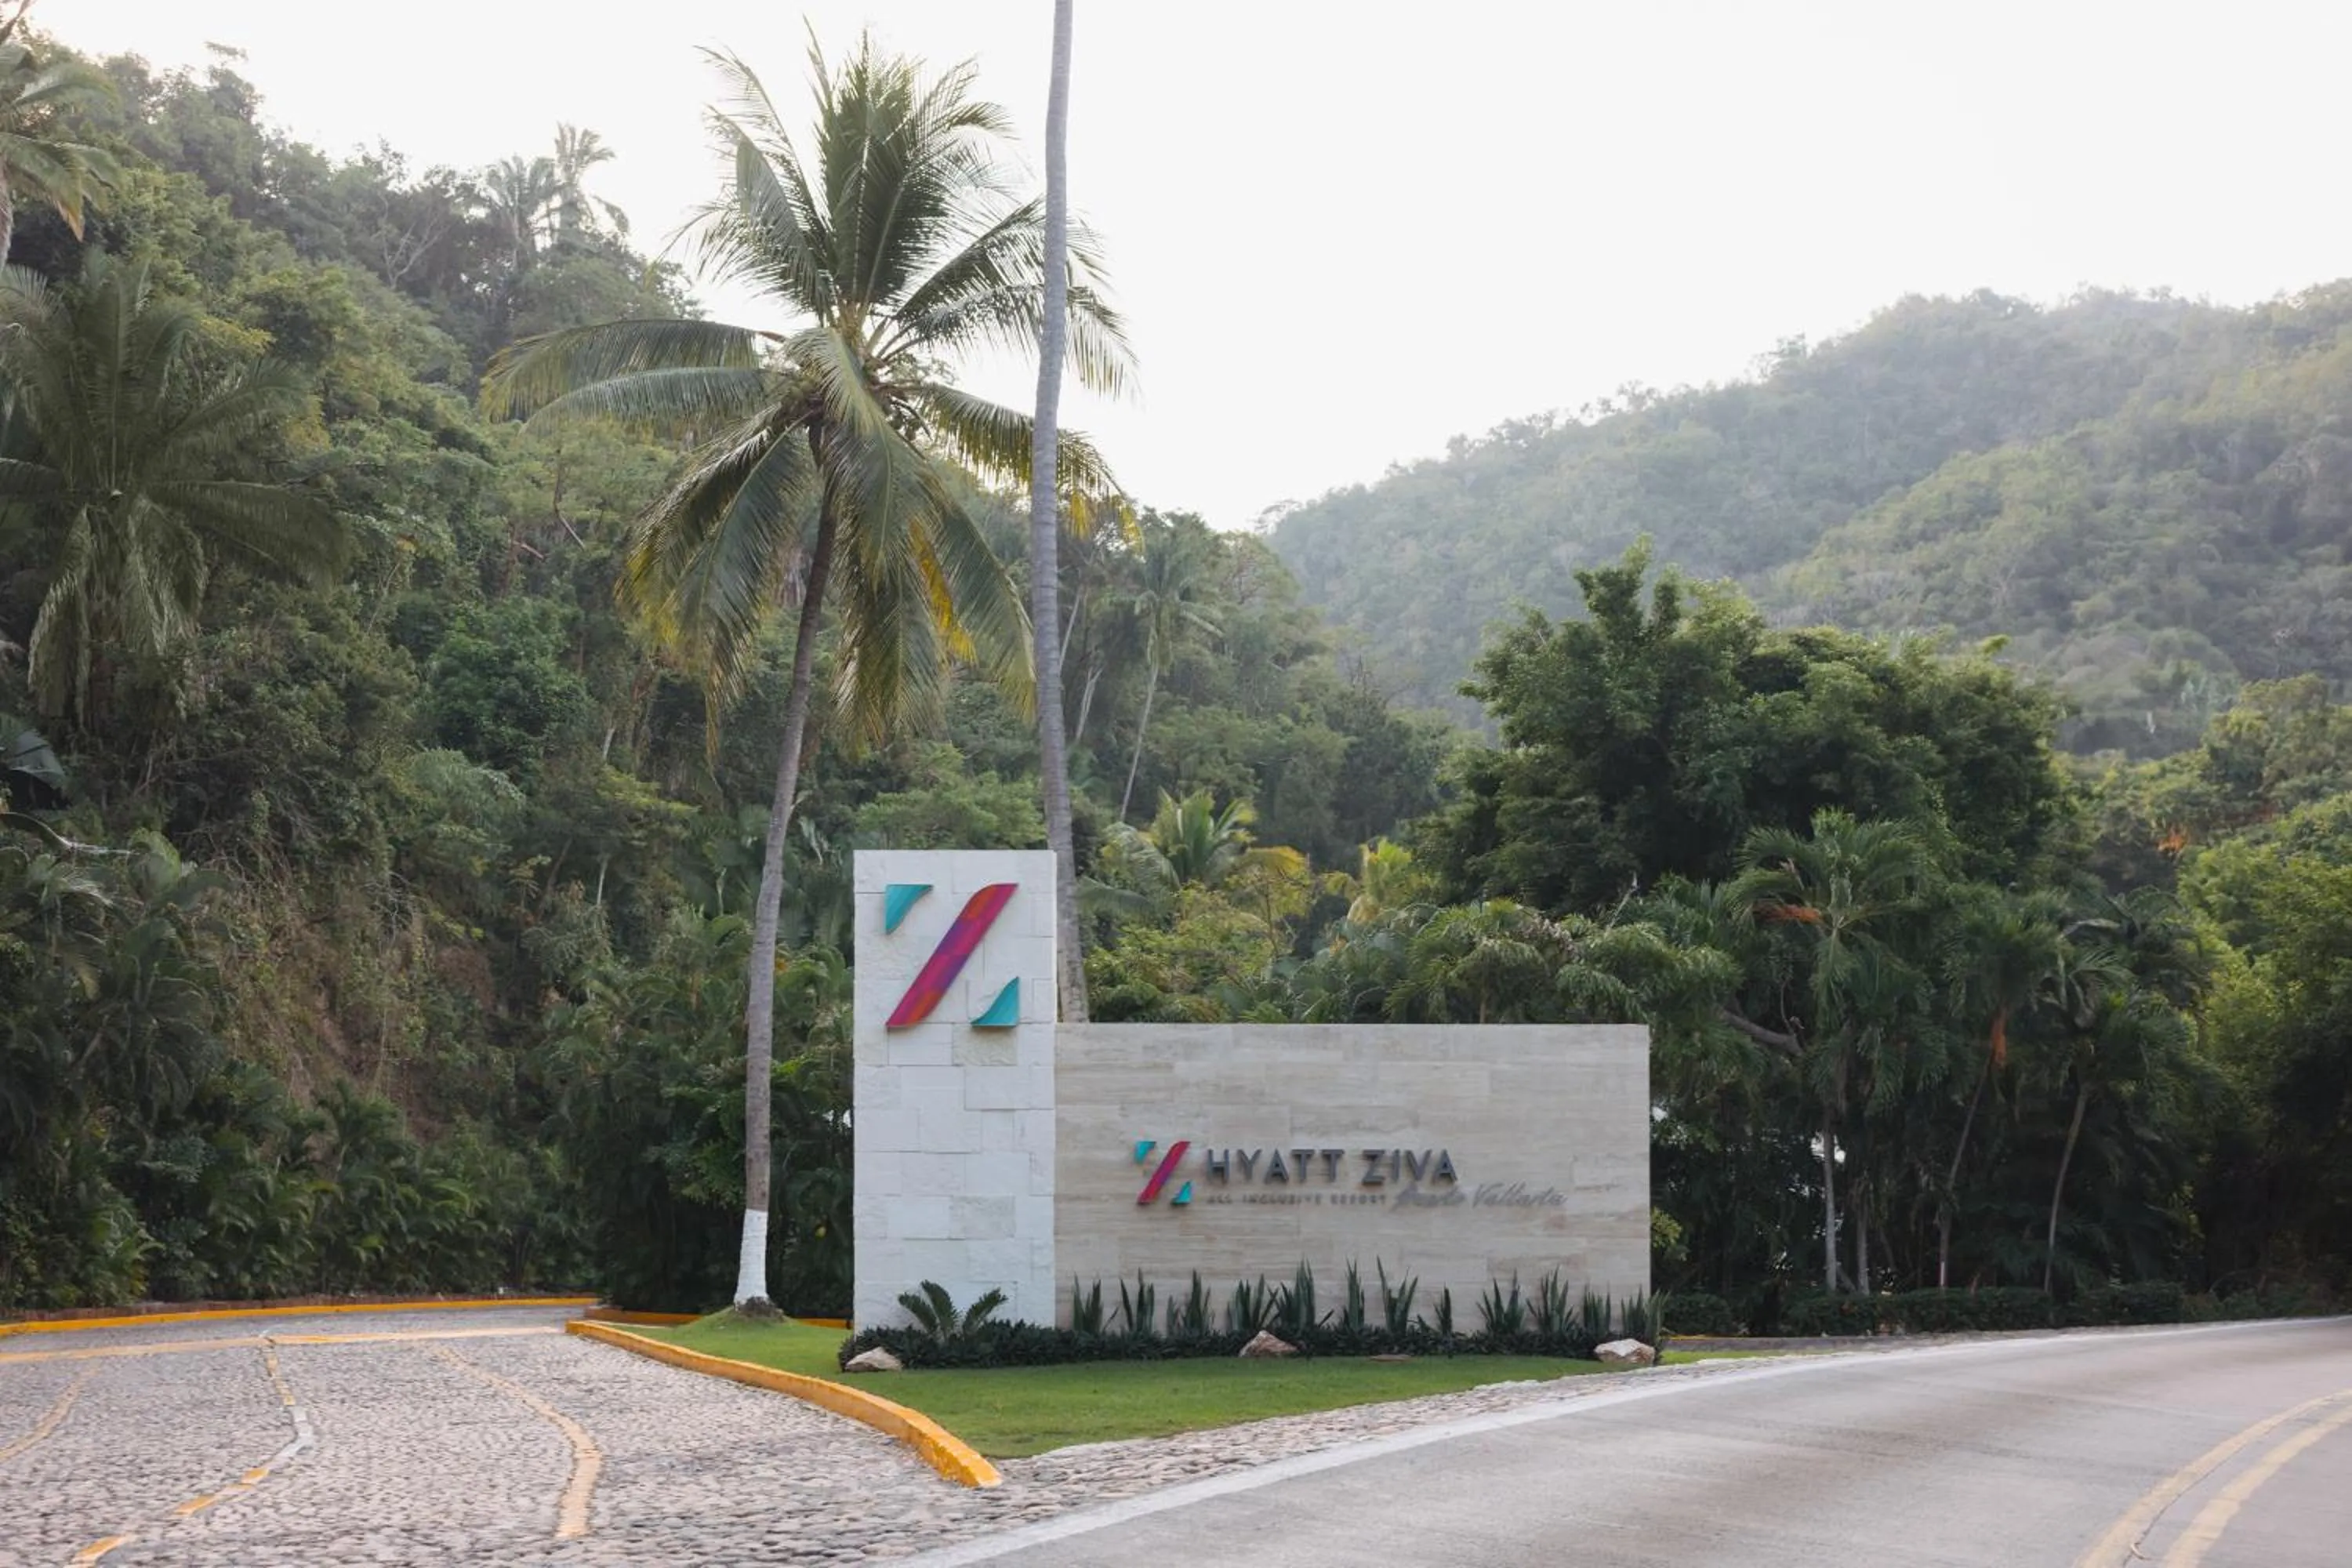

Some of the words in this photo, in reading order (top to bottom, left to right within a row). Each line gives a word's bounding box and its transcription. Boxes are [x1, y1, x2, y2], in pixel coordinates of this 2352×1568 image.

[1206, 1148, 1345, 1184] HYATT
[1360, 1148, 1458, 1185] ZIVA
[1472, 1178, 1568, 1209] Vallarta
